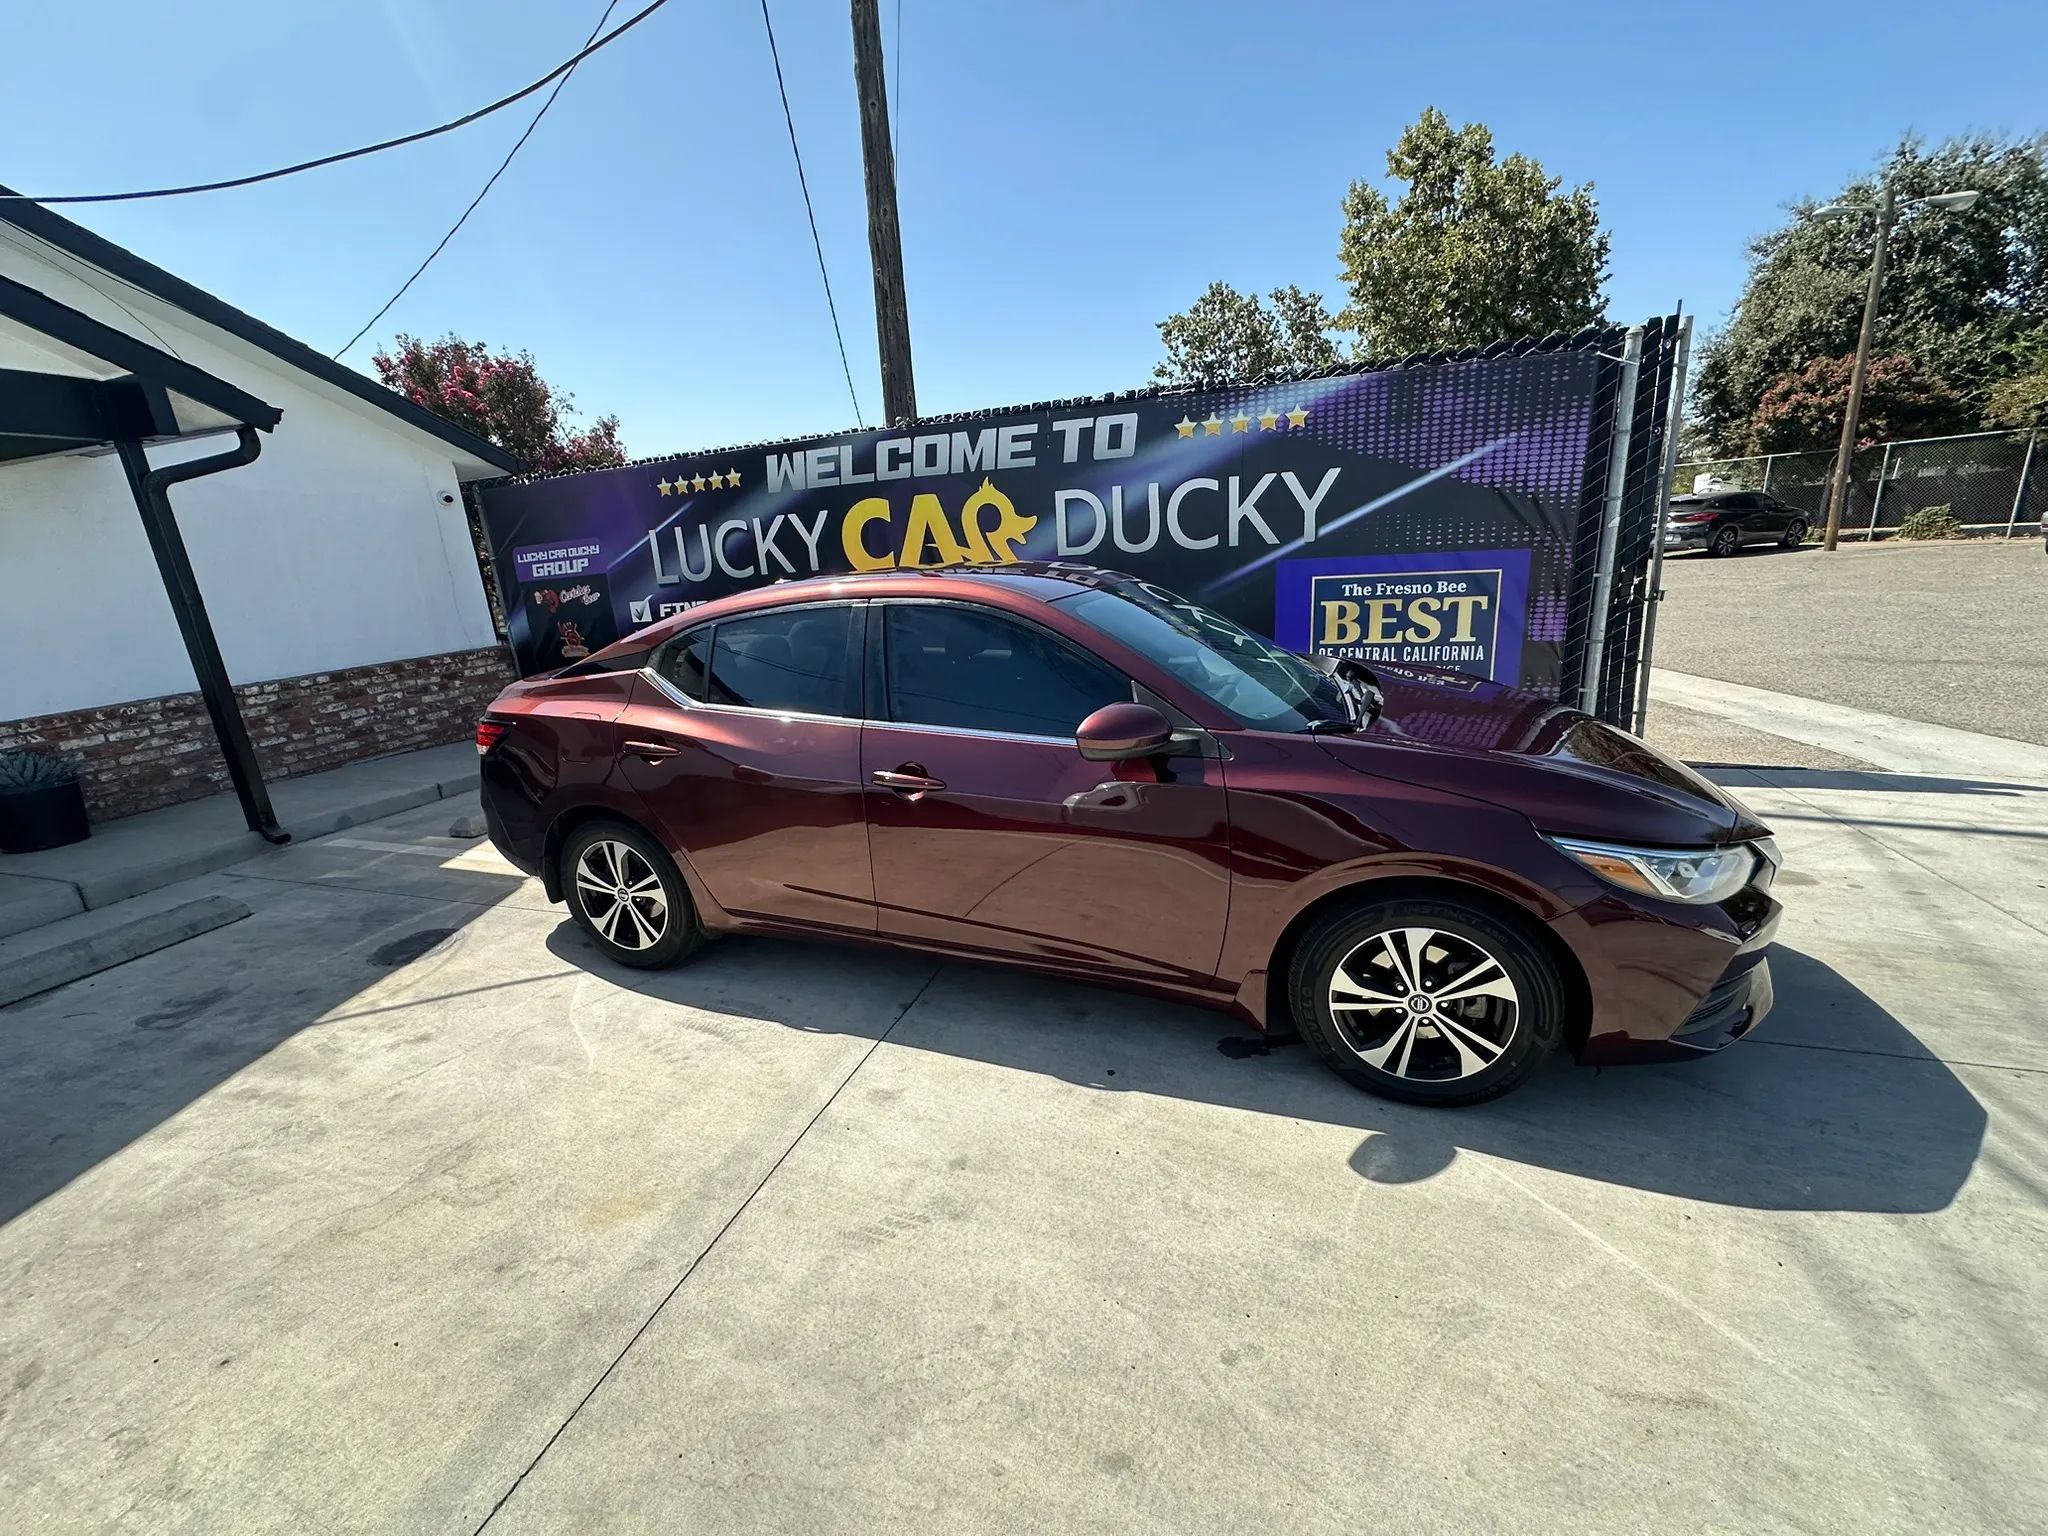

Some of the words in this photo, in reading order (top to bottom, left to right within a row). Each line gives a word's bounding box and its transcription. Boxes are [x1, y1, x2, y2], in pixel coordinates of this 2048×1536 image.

[766, 423, 1038, 493] WELCOME
[1052, 412, 1138, 463] TO
[649, 510, 828, 585] LUCKY
[841, 476, 1038, 571] CAR
[1054, 467, 1342, 556] DUCKY
[517, 550, 548, 563] LUCKY
[549, 548, 568, 559] CAR
[569, 544, 600, 557] DUCKY
[532, 558, 589, 577] GROUP
[1342, 583, 1372, 596] The
[1375, 581, 1432, 596] Fresno
[1436, 580, 1467, 593] Bee
[1319, 595, 1488, 645] BEST
[1339, 646, 1398, 662] CENTRAL
[1403, 645, 1484, 662] CALIFORNIA
